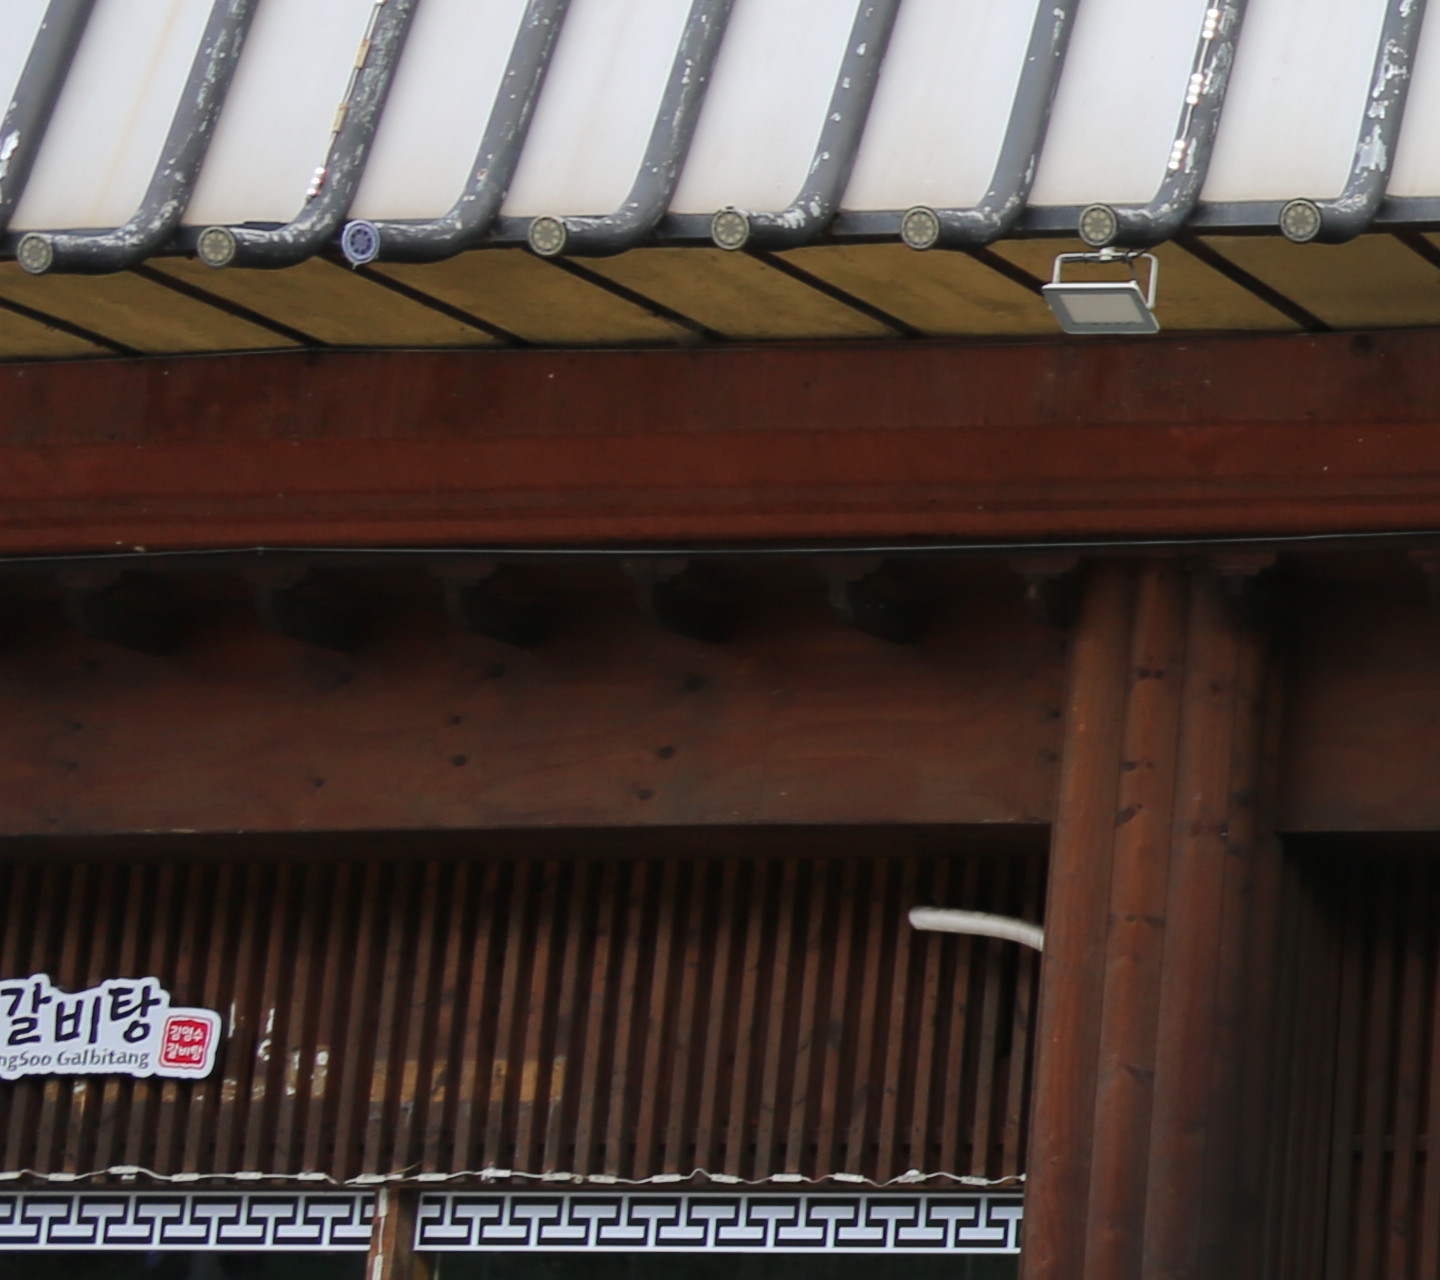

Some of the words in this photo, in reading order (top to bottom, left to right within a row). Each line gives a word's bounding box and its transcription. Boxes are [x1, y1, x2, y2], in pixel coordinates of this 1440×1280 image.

[0, 982, 161, 1046] 갈비탕
[169, 1026, 204, 1042] 김영수
[57, 1048, 150, 1070] Galbitang
[166, 1042, 203, 1061] 갈비탕
